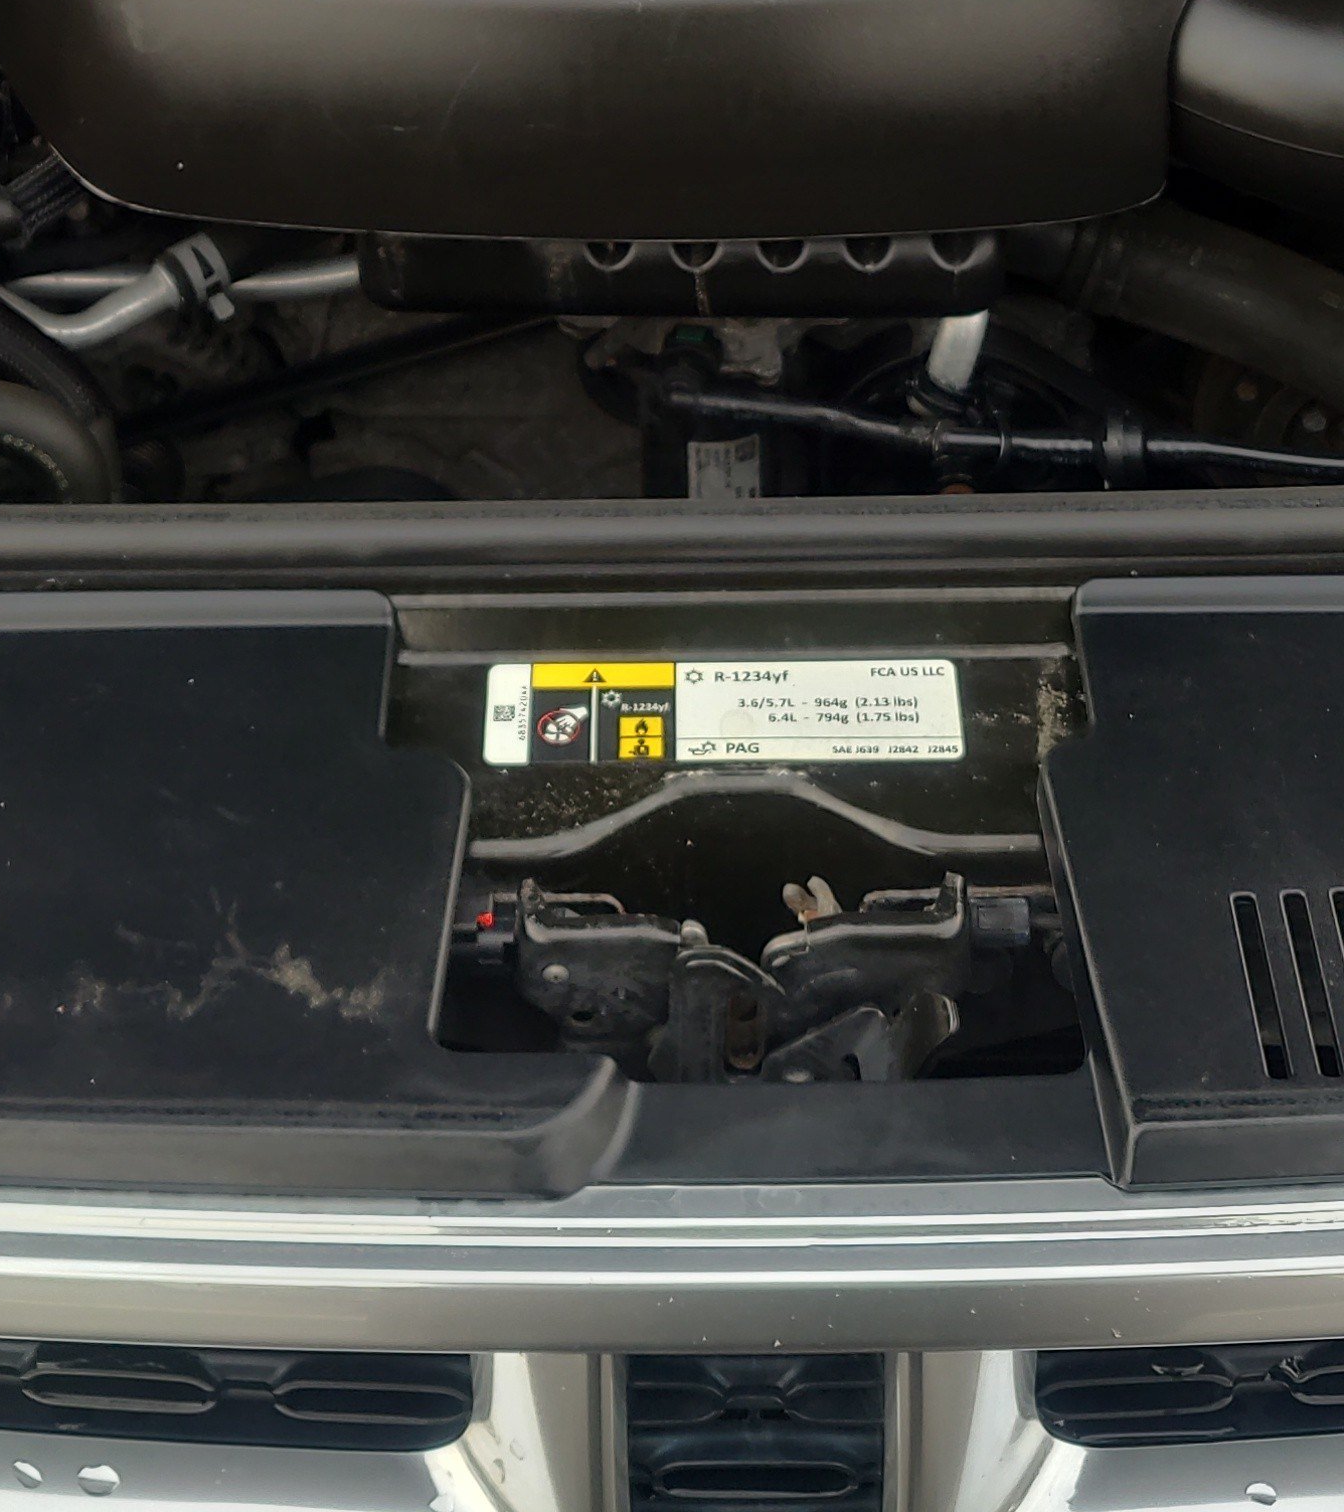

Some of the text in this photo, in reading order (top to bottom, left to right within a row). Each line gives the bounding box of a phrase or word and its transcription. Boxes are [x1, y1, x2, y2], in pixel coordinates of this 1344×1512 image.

[714, 670, 789, 684] R-1234yf
[870, 667, 945, 677] FCA US LLC
[621, 702, 669, 713] R-1234yf
[737, 697, 795, 709] 3.6/5.7L
[814, 697, 848, 709] 964g
[856, 696, 890, 708] (2.13
[893, 696, 918, 708] lbs)
[768, 713, 797, 722] 6.4L
[817, 713, 849, 724] 794g
[857, 712, 891, 723] (1.75
[895, 712, 919, 723] lbs)
[725, 742, 760, 754] PAG
[832, 745, 853, 754] SAE
